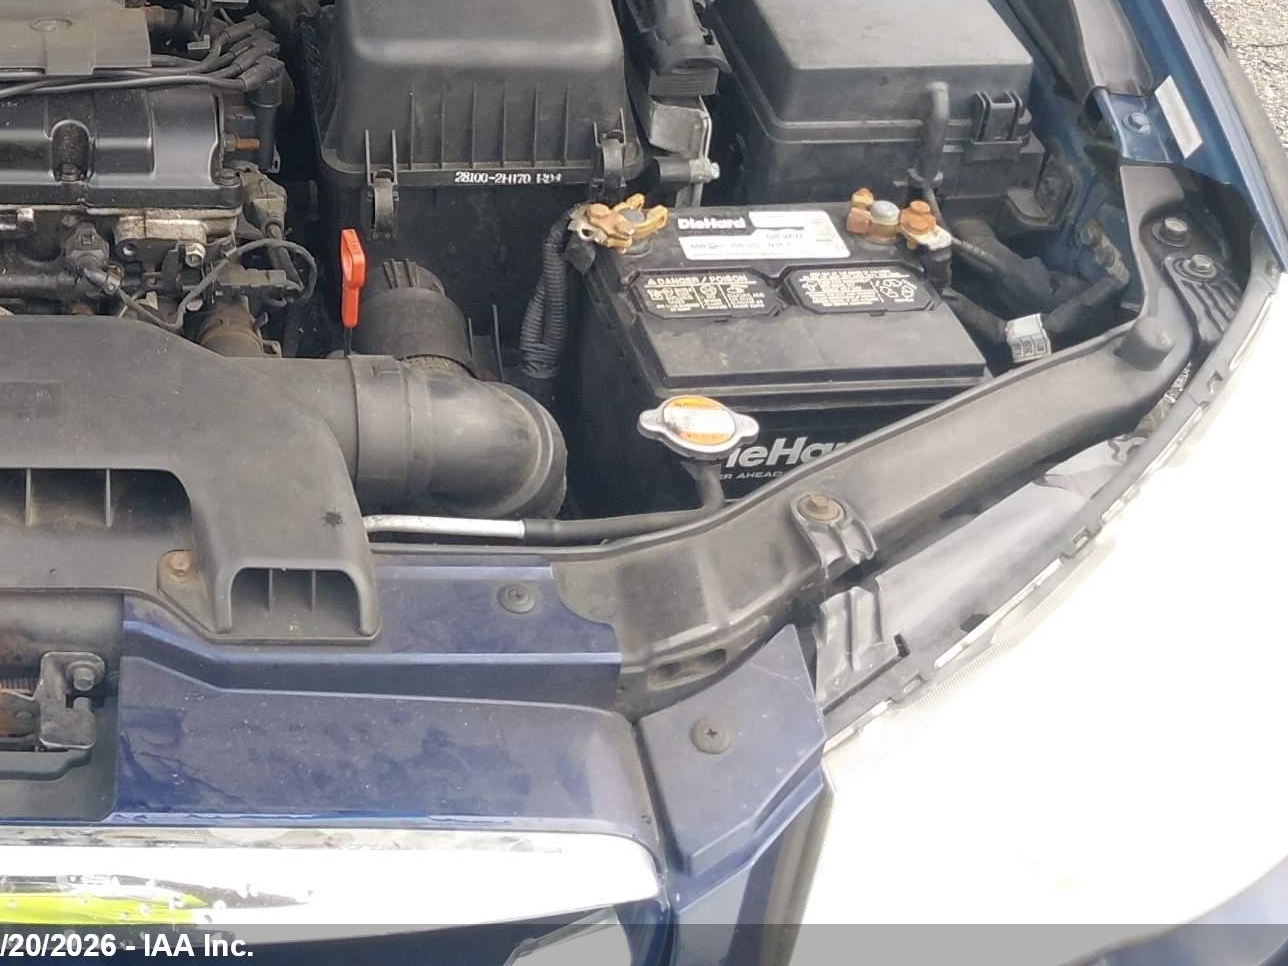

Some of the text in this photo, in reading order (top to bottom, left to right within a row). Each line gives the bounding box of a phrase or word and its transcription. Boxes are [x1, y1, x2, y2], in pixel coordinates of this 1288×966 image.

[678, 218, 746, 229] DieHard
[657, 277, 699, 285] DANGER
[709, 274, 748, 283] POISON
[725, 436, 848, 468] ieHa
